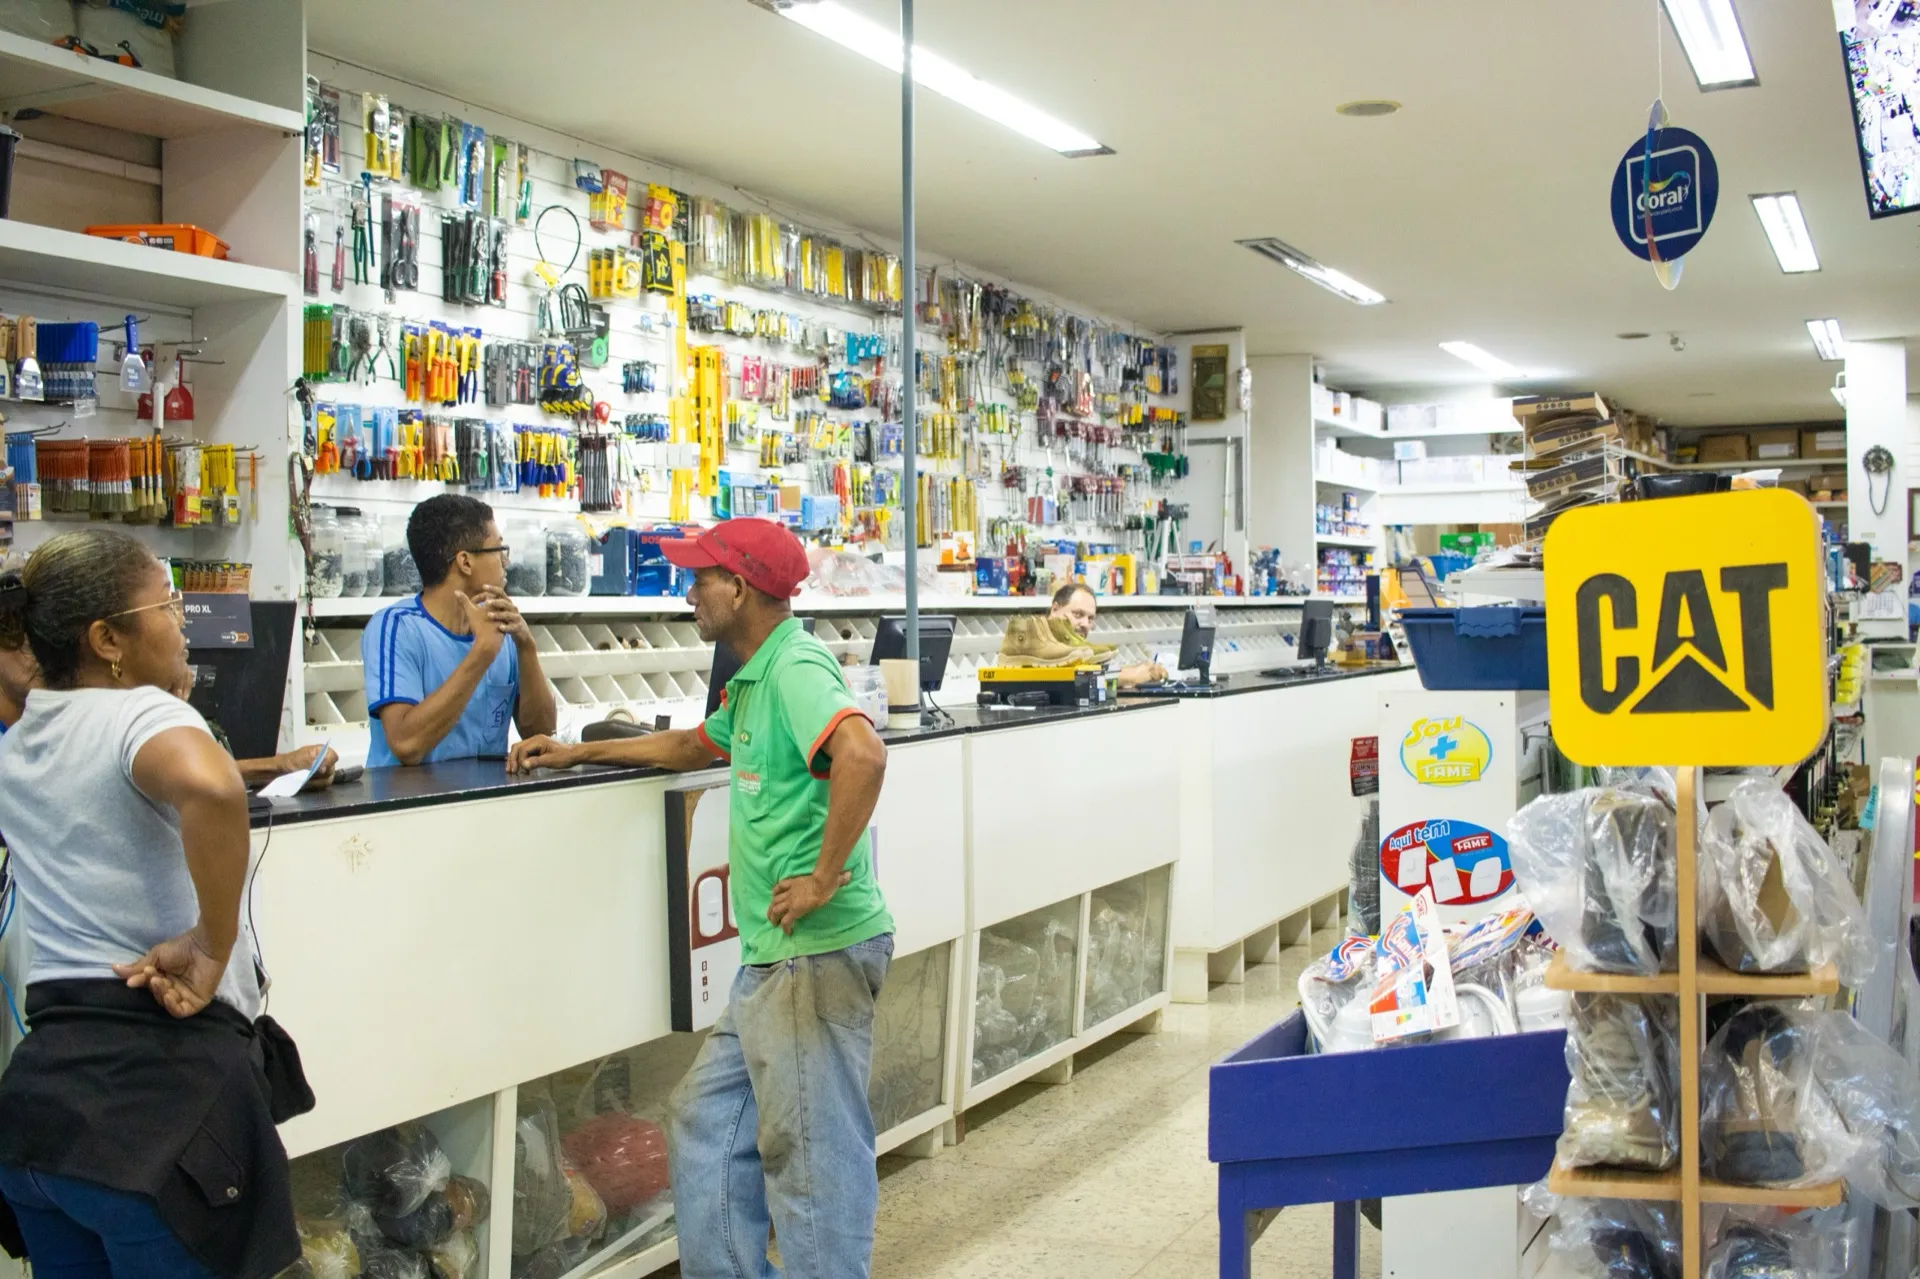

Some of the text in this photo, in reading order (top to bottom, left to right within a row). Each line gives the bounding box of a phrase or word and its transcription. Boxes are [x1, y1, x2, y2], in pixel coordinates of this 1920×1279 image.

[1636, 185, 1683, 212] Coral
[185, 604, 212, 613] PRO XL
[1575, 562, 1789, 715] CAT
[983, 670, 995, 679] CAT
[1404, 715, 1464, 747] Sou
[1421, 762, 1474, 779] FAME
[1389, 820, 1450, 852] Aqui tem
[1454, 836, 1490, 852] FAME
